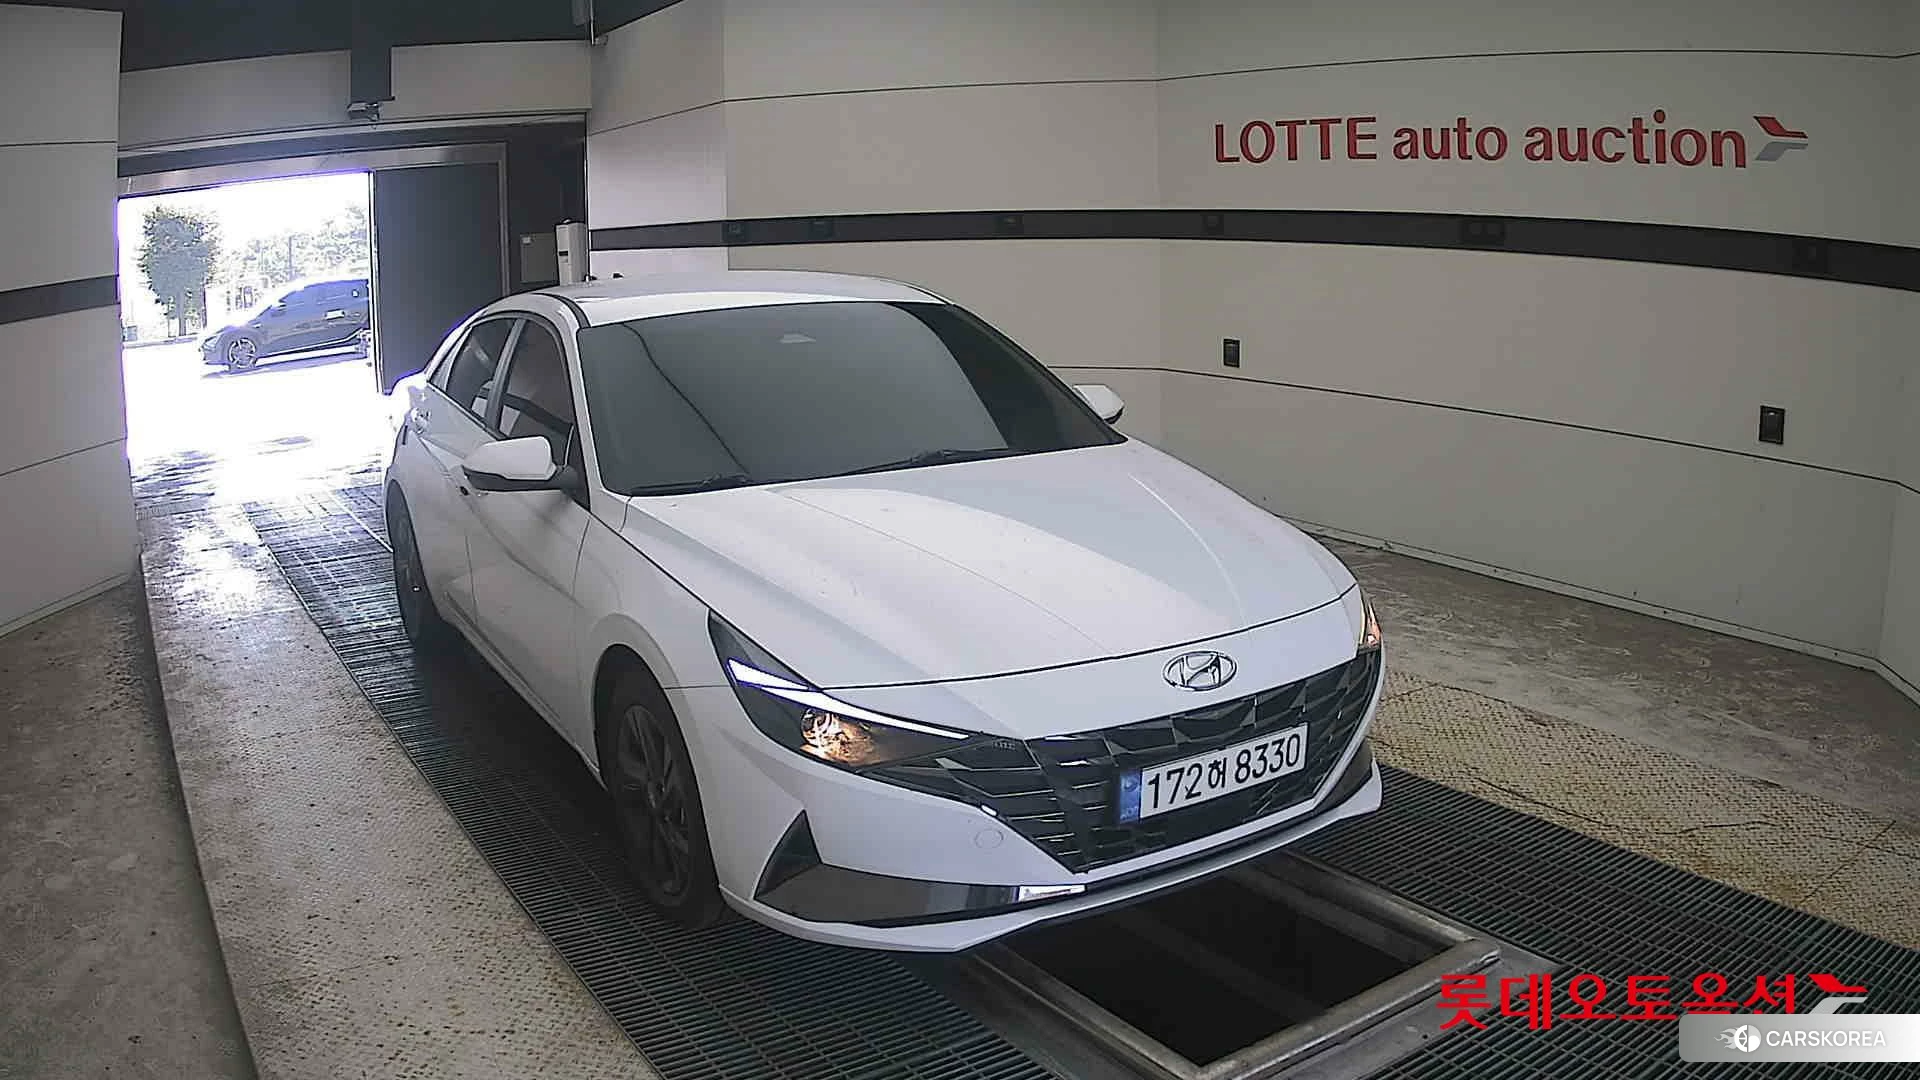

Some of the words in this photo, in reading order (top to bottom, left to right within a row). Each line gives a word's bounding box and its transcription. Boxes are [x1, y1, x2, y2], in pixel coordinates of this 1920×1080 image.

[1215, 117, 1375, 162] LOTTE
[1392, 118, 1509, 161] auto
[1524, 111, 1747, 168] auction
